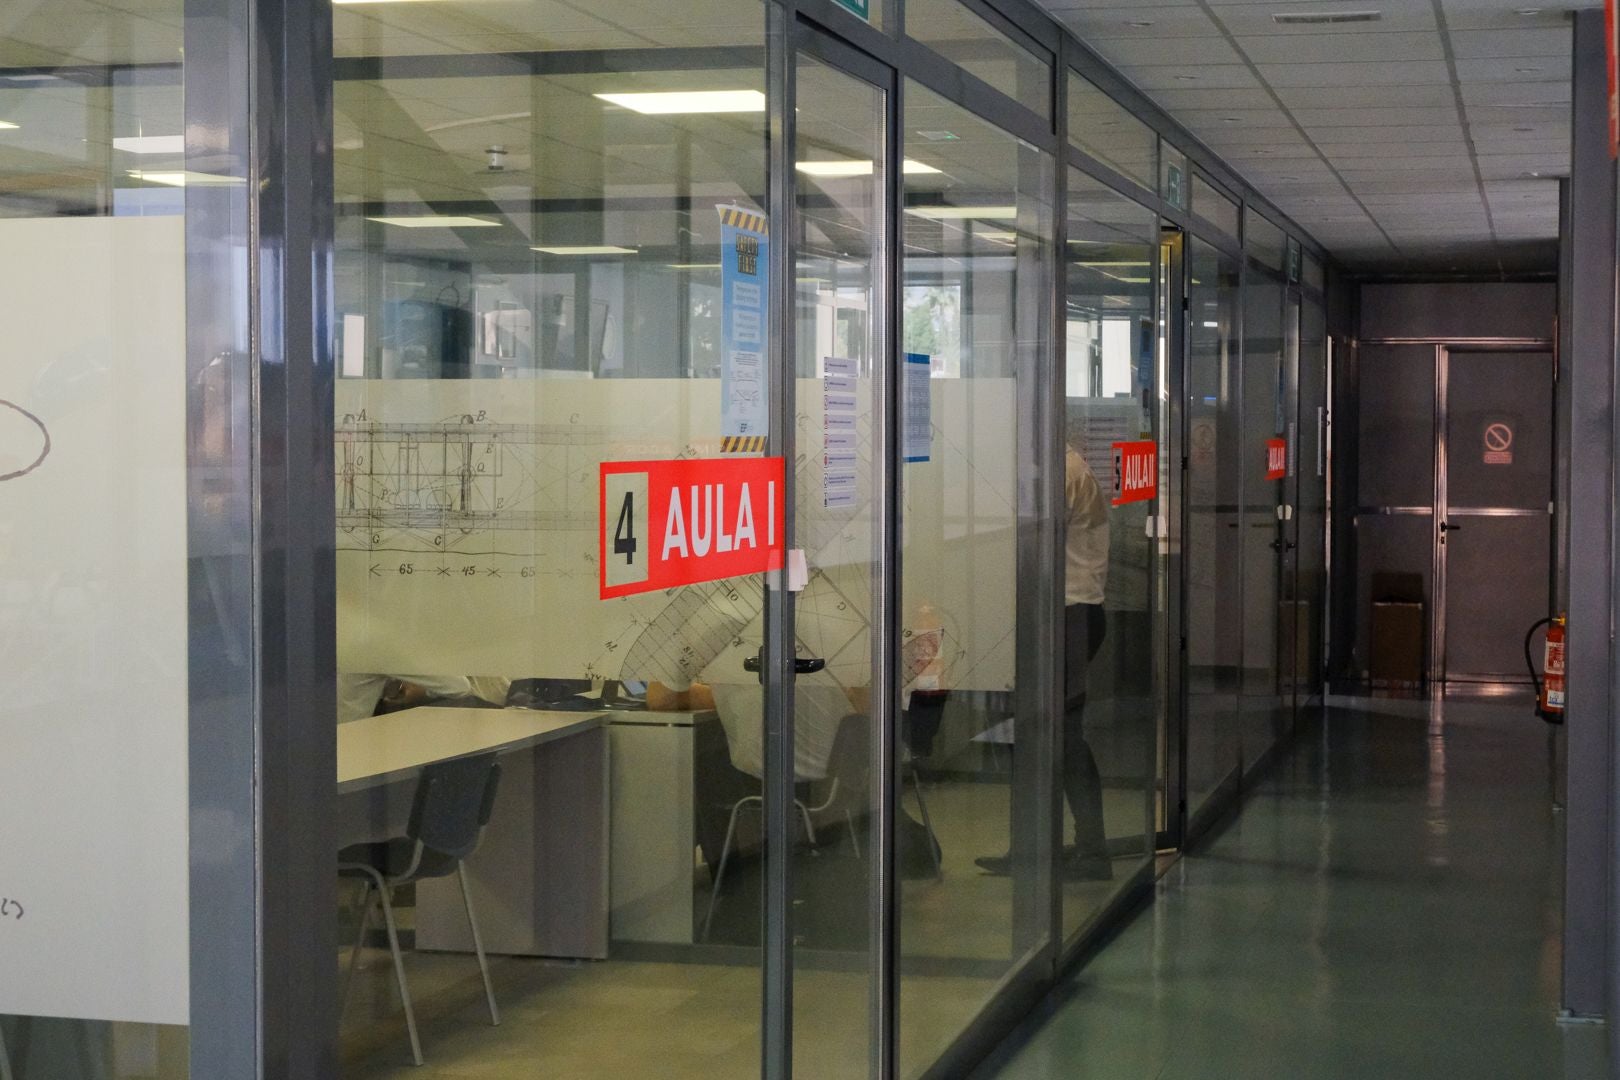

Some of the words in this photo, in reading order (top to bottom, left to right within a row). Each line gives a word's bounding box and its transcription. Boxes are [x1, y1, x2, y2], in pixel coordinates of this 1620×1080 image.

[356, 407, 368, 422] A
[476, 409, 487, 422] B
[1124, 454, 1149, 491] AULA
[614, 491, 637, 565] 4
[661, 482, 757, 561] AULA
[767, 480, 775, 546] I
[399, 563, 414, 575] 65
[461, 565, 476, 576] 45
[521, 566, 536, 578] 65
